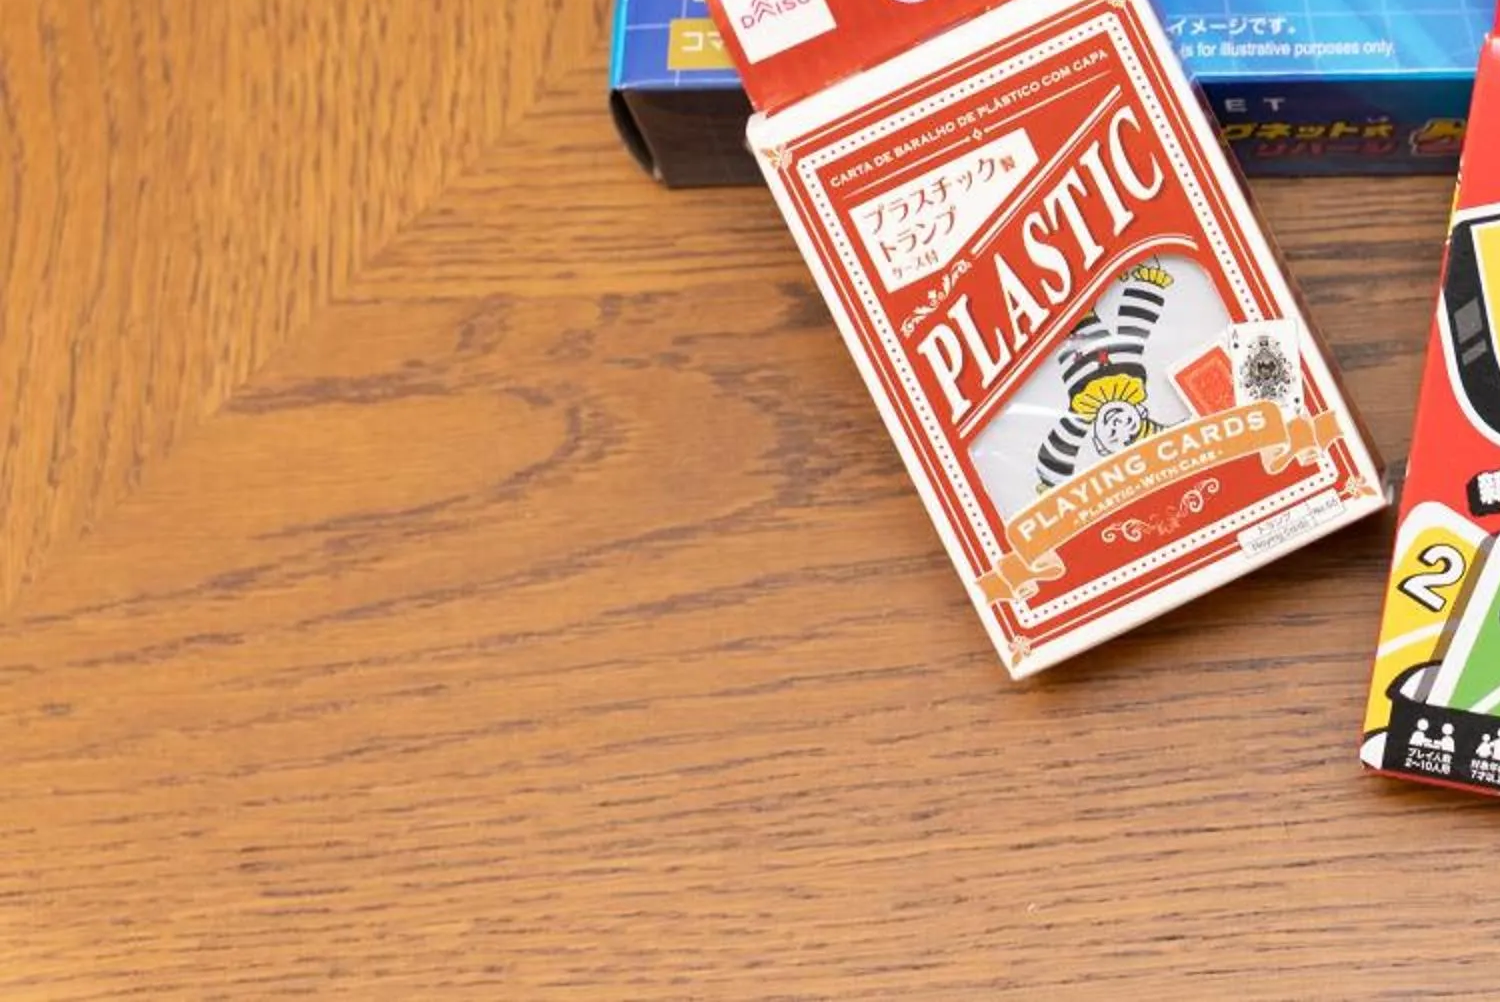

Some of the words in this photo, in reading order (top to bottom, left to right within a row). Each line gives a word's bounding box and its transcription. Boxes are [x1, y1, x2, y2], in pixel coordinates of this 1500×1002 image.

[1041, 65, 1072, 87] COM
[1073, 49, 1109, 71] CAPA
[1197, 41, 1217, 57] for
[1220, 41, 1290, 57] illustrative
[1294, 43, 1359, 59] purposes
[879, 205, 957, 263] トランプ
[917, 104, 1164, 425] PLASTIC
[1017, 454, 1148, 542] PLAYING
[1156, 410, 1268, 461] CARDS
[1397, 543, 1466, 612] 2
